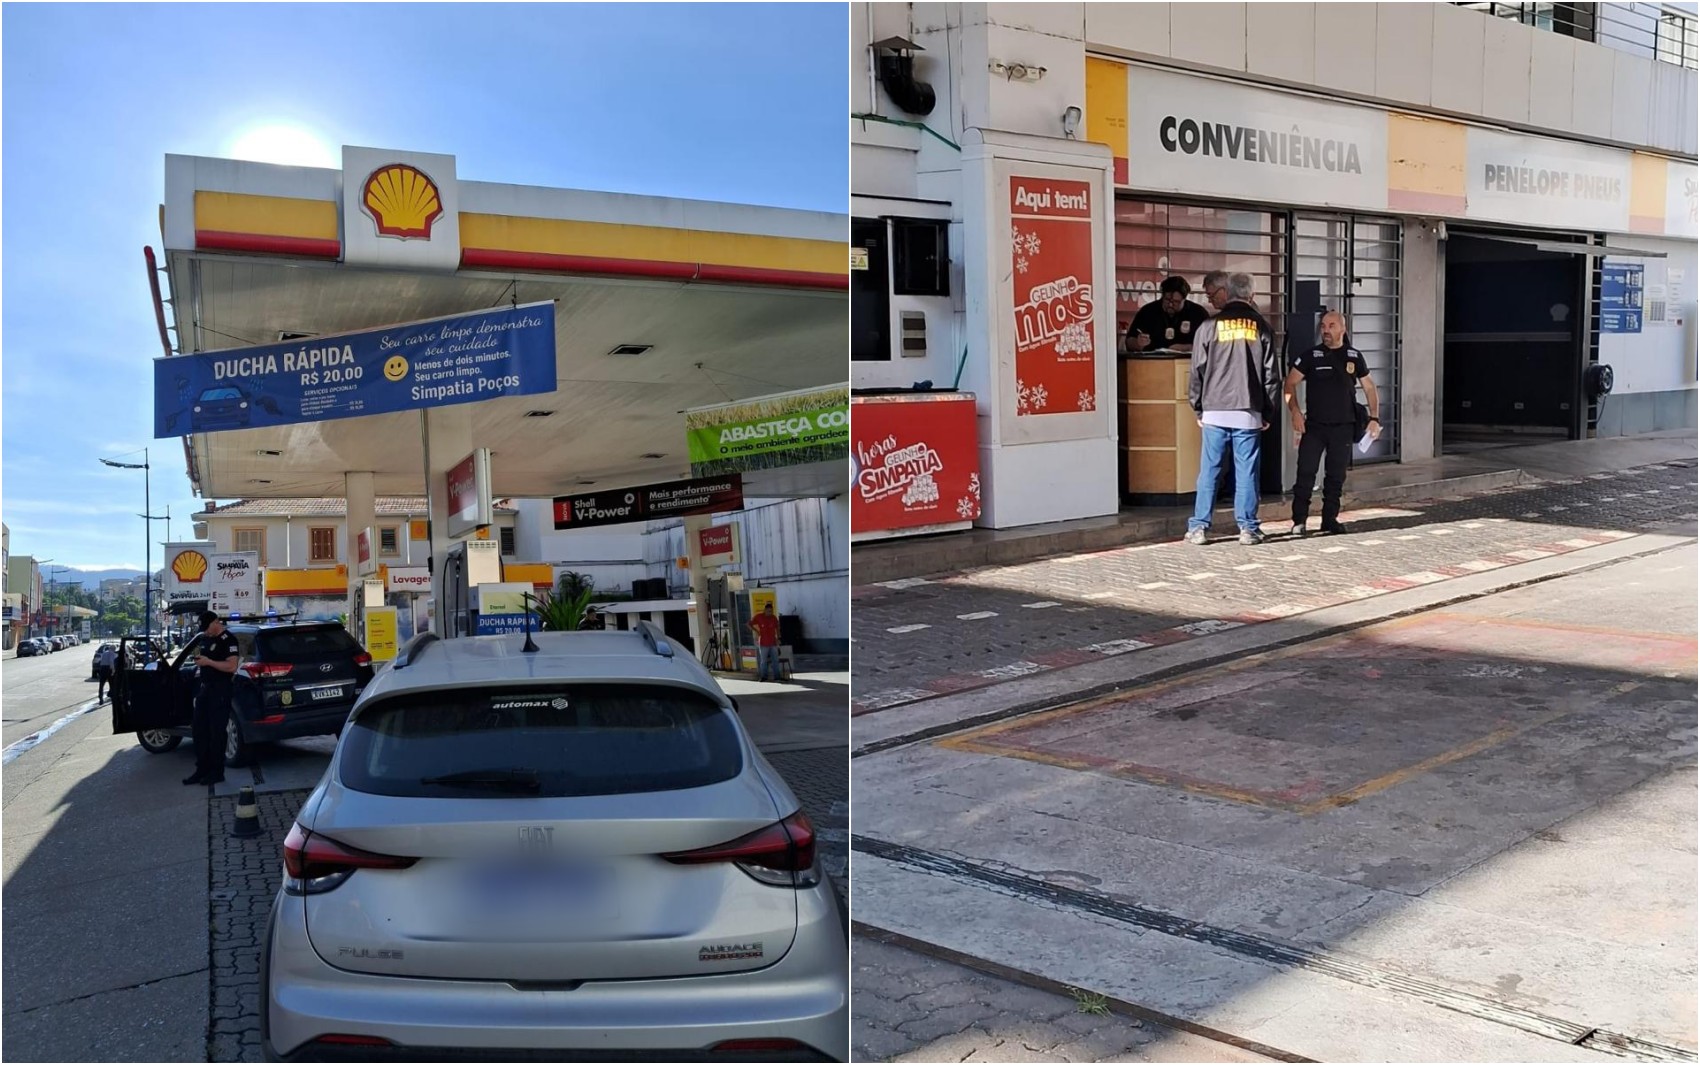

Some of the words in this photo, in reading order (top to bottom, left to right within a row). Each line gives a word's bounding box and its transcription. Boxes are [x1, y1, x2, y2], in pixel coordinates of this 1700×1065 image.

[1160, 115, 1361, 174] CONVENIÊNCIA
[1484, 159, 1569, 197] PENÉLOPE
[1574, 172, 1621, 201] PNEUS
[1015, 186, 1051, 212] Aqui
[1055, 190, 1087, 210] tem!
[1031, 279, 1076, 303] GELINHO
[379, 335, 402, 350] Seu
[405, 333, 436, 346] carro
[440, 326, 473, 342] limpo
[476, 316, 543, 334] demonstra
[425, 345, 445, 357] seu
[448, 334, 498, 352] cuidado
[214, 354, 278, 380] DUCHA
[283, 345, 355, 372] RÁPIDA
[414, 359, 442, 371] Menos
[443, 357, 454, 367] de
[455, 354, 473, 365] dois
[475, 349, 512, 363] minutos.
[301, 371, 319, 386] R$
[323, 366, 363, 384] 20,00
[414, 371, 431, 382] Seu
[432, 370, 455, 380] carro
[456, 366, 483, 378] limpo.
[411, 380, 474, 400] Simpatia
[478, 375, 520, 391] Poços
[719, 416, 813, 444] ABASTEÇA
[719, 446, 729, 454] O
[731, 443, 754, 453] meio
[756, 436, 800, 449] ambiente
[857, 434, 897, 466] horas
[886, 445, 925, 466] GELINHO
[860, 451, 941, 495] SIMPATIA
[574, 498, 596, 509] Shell
[649, 490, 671, 500] Mais
[672, 482, 732, 499] performance
[575, 505, 631, 520] V-Power
[703, 536, 729, 547] V-Power
[479, 618, 506, 626] DUCHA
[507, 616, 536, 626] RÁPIA
[492, 701, 550, 709] automax
[339, 946, 404, 960] PULSE
